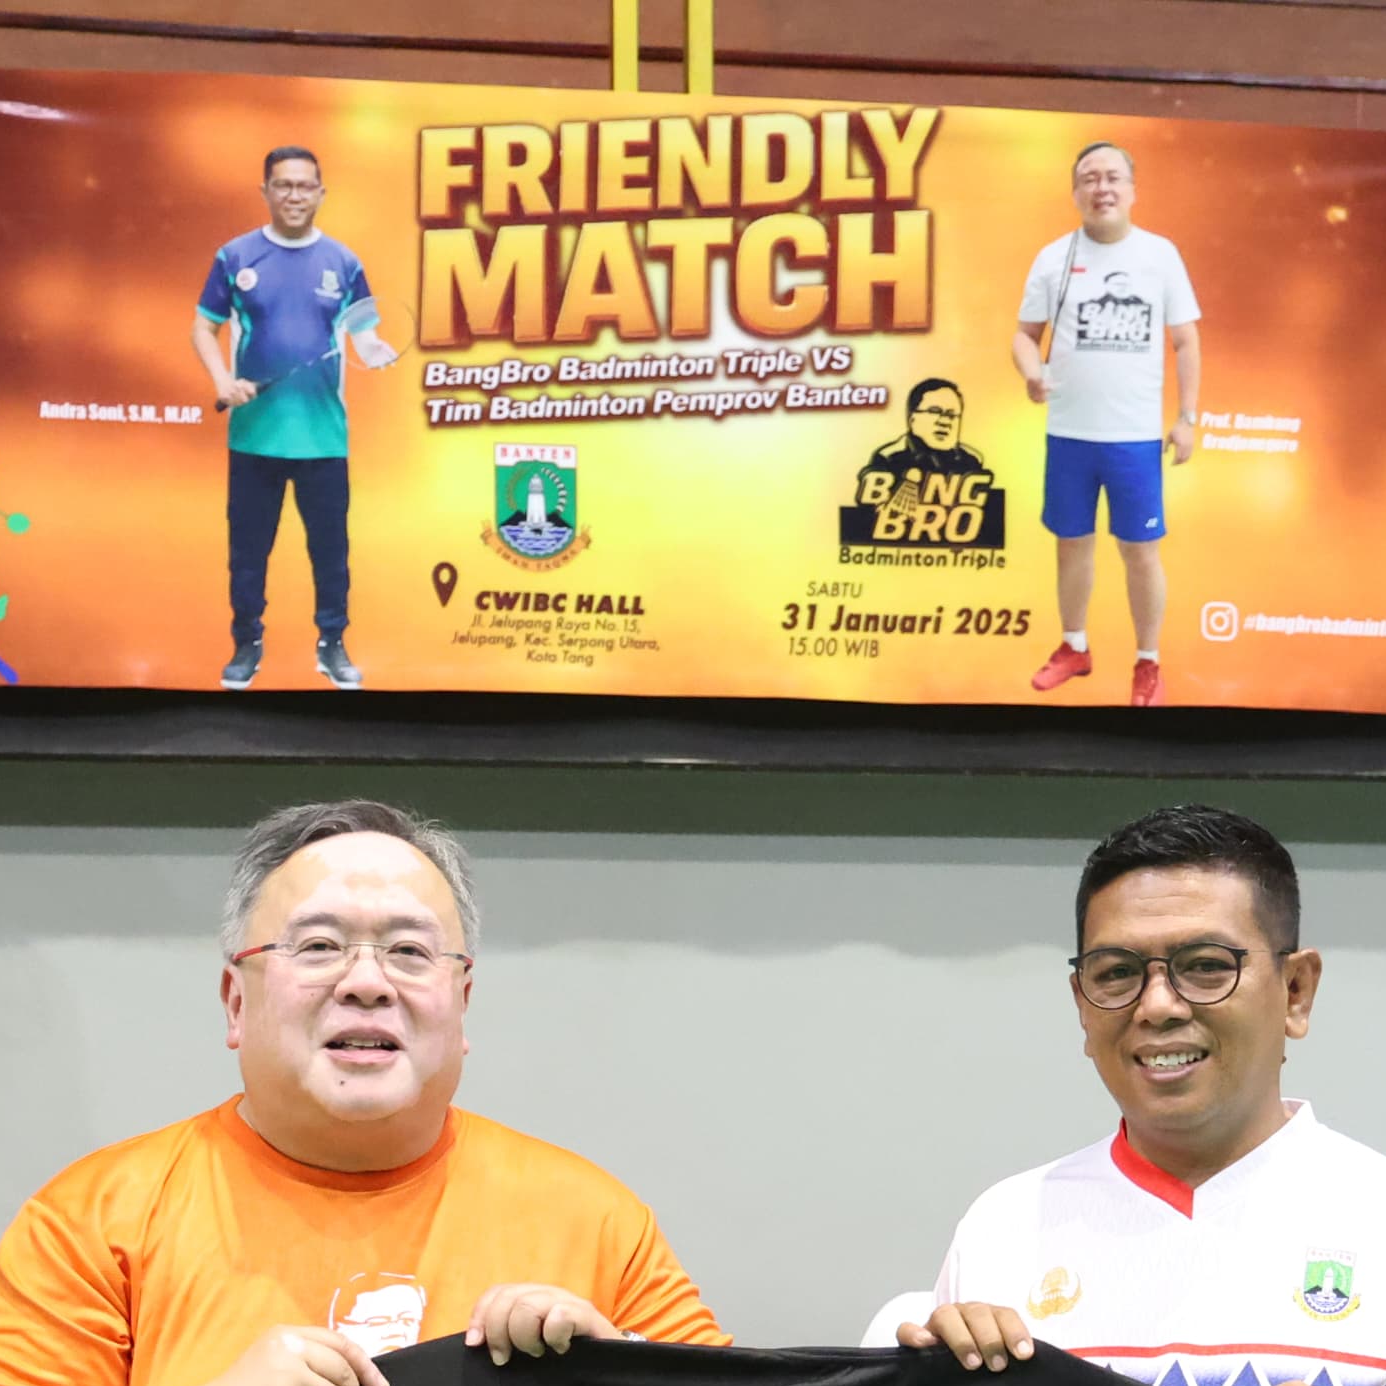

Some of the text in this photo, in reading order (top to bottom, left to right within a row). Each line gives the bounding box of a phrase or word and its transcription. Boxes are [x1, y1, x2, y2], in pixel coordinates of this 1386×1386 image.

[419, 107, 940, 218] FRIENDLY
[419, 210, 933, 346] MATCH
[425, 347, 851, 390] BangBro Badminton Triple VS
[40, 401, 86, 419] Andra
[88, 403, 127, 422] Soni,
[427, 384, 887, 423] Tim Badminton Pemprov Banten
[501, 448, 570, 459] BANTEN
[872, 503, 984, 543] BRO
[839, 547, 1006, 570] Badminton Triple
[806, 581, 864, 598] SABTU
[475, 591, 645, 615] CWIBC HALL
[489, 615, 552, 633] Jelupang
[556, 617, 590, 634] Raya
[595, 619, 617, 632] No.
[781, 603, 1031, 636] 31 Januari 2025
[451, 631, 660, 651] Jelupang, Kec. Serpong Utara,
[788, 637, 880, 658] 15.00 WIB
[526, 650, 594, 667] Kota Tang
